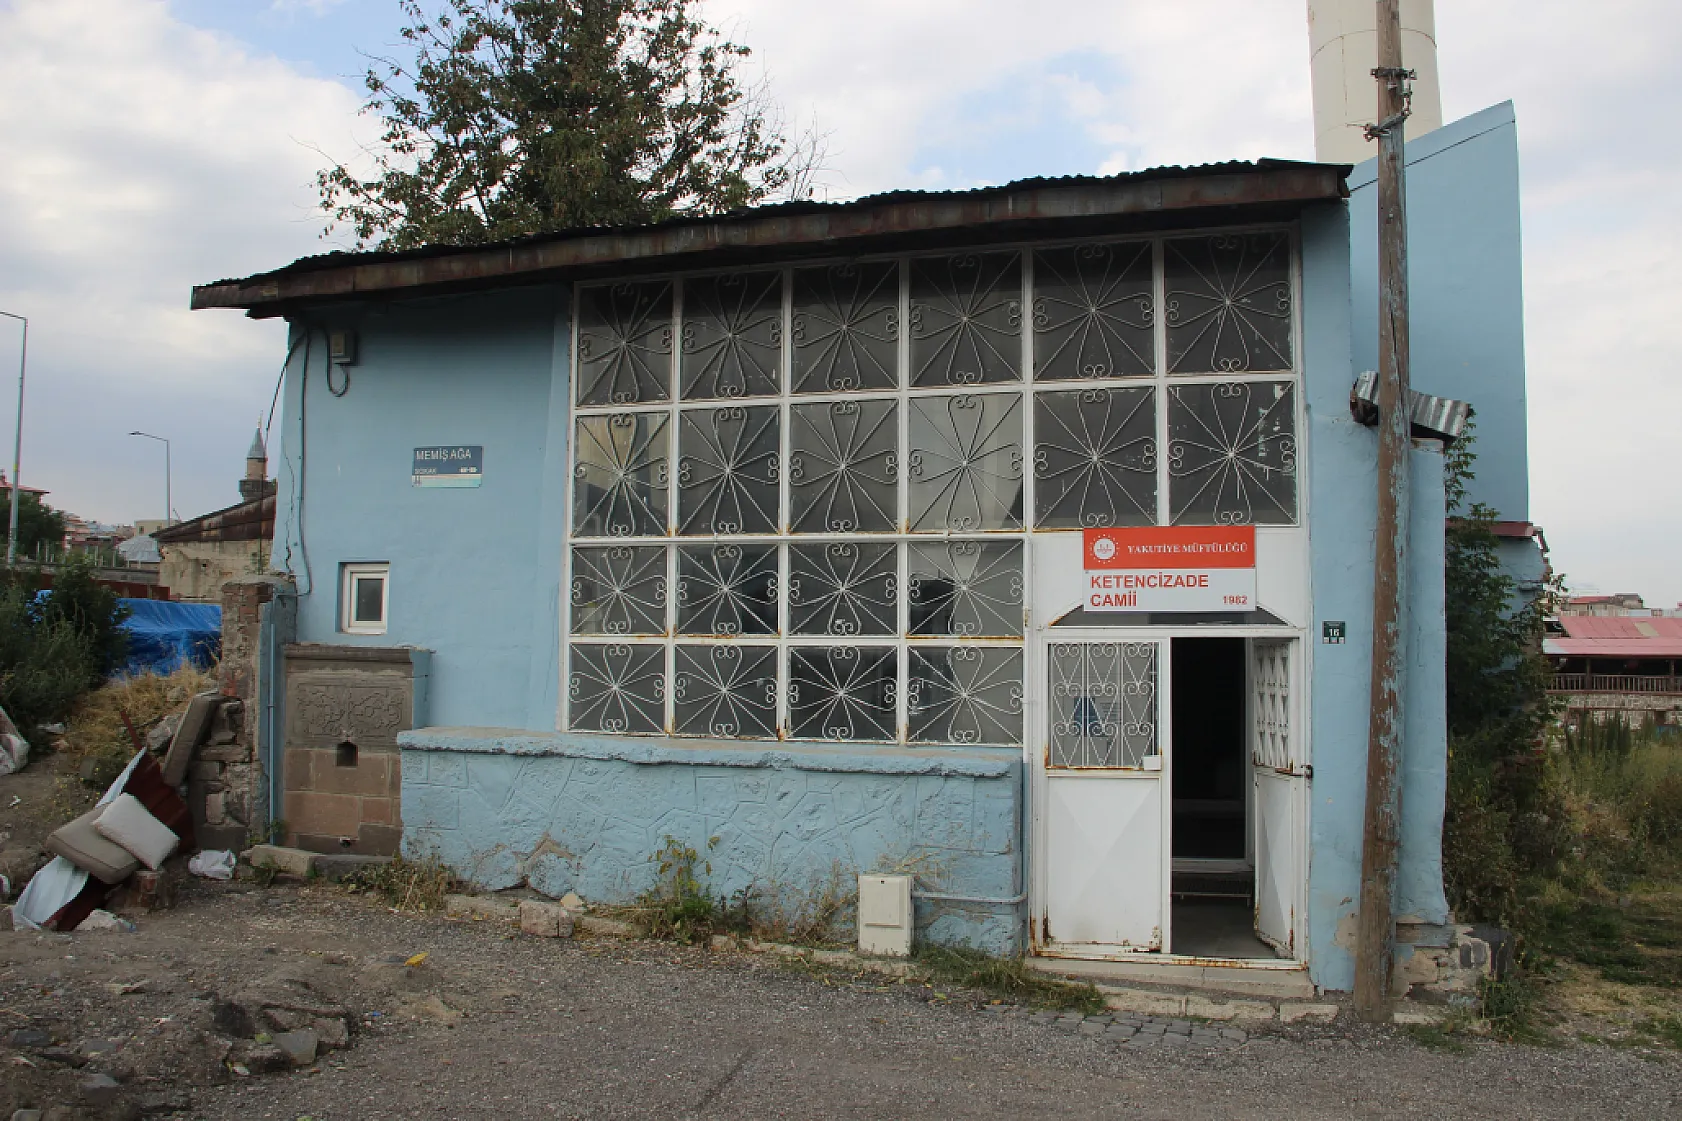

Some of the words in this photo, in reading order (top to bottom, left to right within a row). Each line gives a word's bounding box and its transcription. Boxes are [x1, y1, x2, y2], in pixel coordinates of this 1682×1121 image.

[1127, 543, 1179, 554] YAKUTİYE
[1182, 542, 1248, 553] MÜFTÜLÜĞÜ
[1090, 571, 1209, 589] KETENCİZADE
[1223, 595, 1248, 606] 1982
